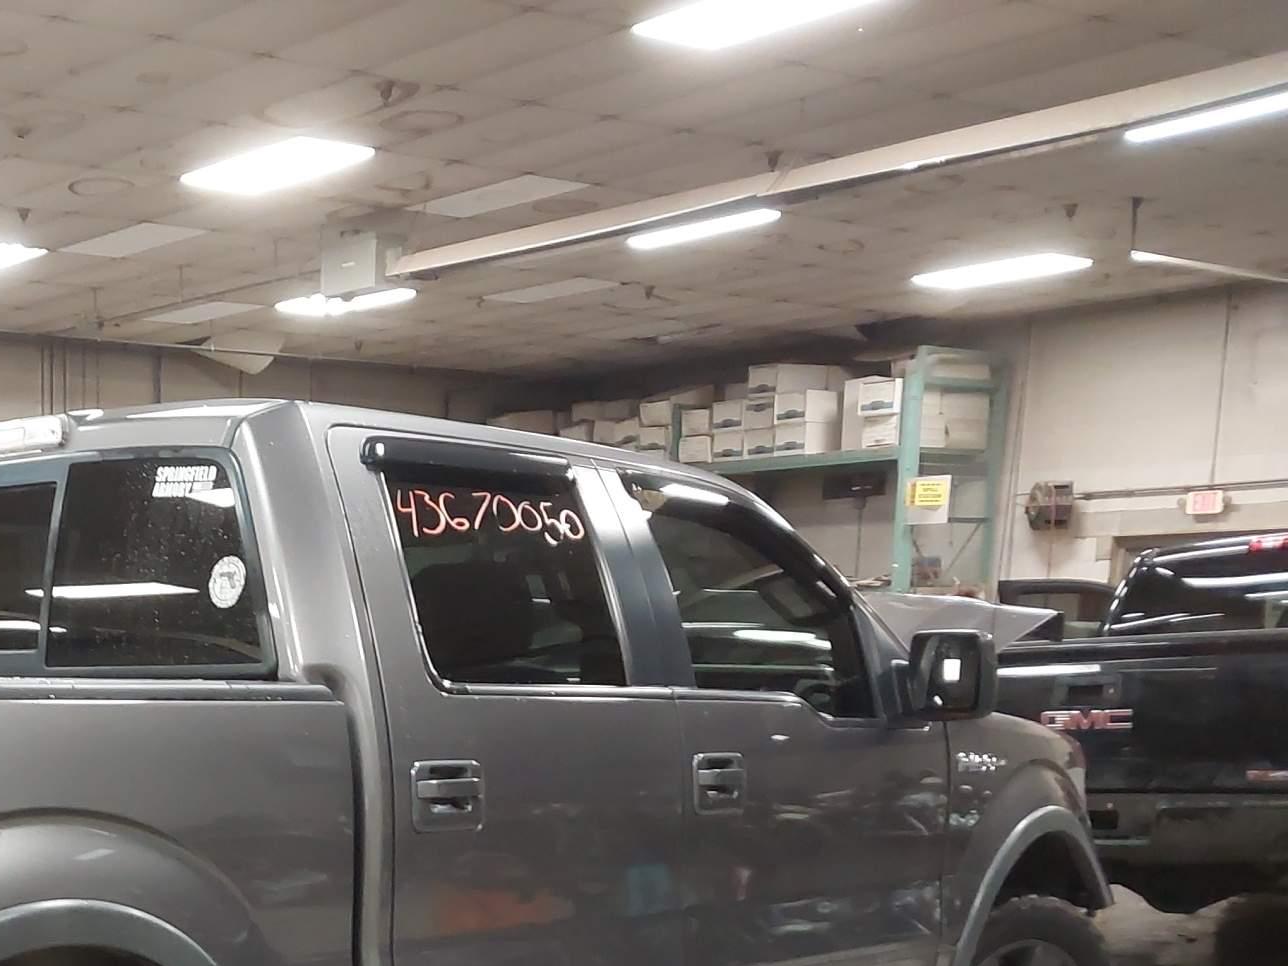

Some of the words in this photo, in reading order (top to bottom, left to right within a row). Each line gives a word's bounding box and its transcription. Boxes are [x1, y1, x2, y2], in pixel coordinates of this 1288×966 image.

[155, 465, 218, 482] SPRINGFIELD
[396, 489, 585, 547] 43670050
[1040, 708, 1134, 730] GMC
